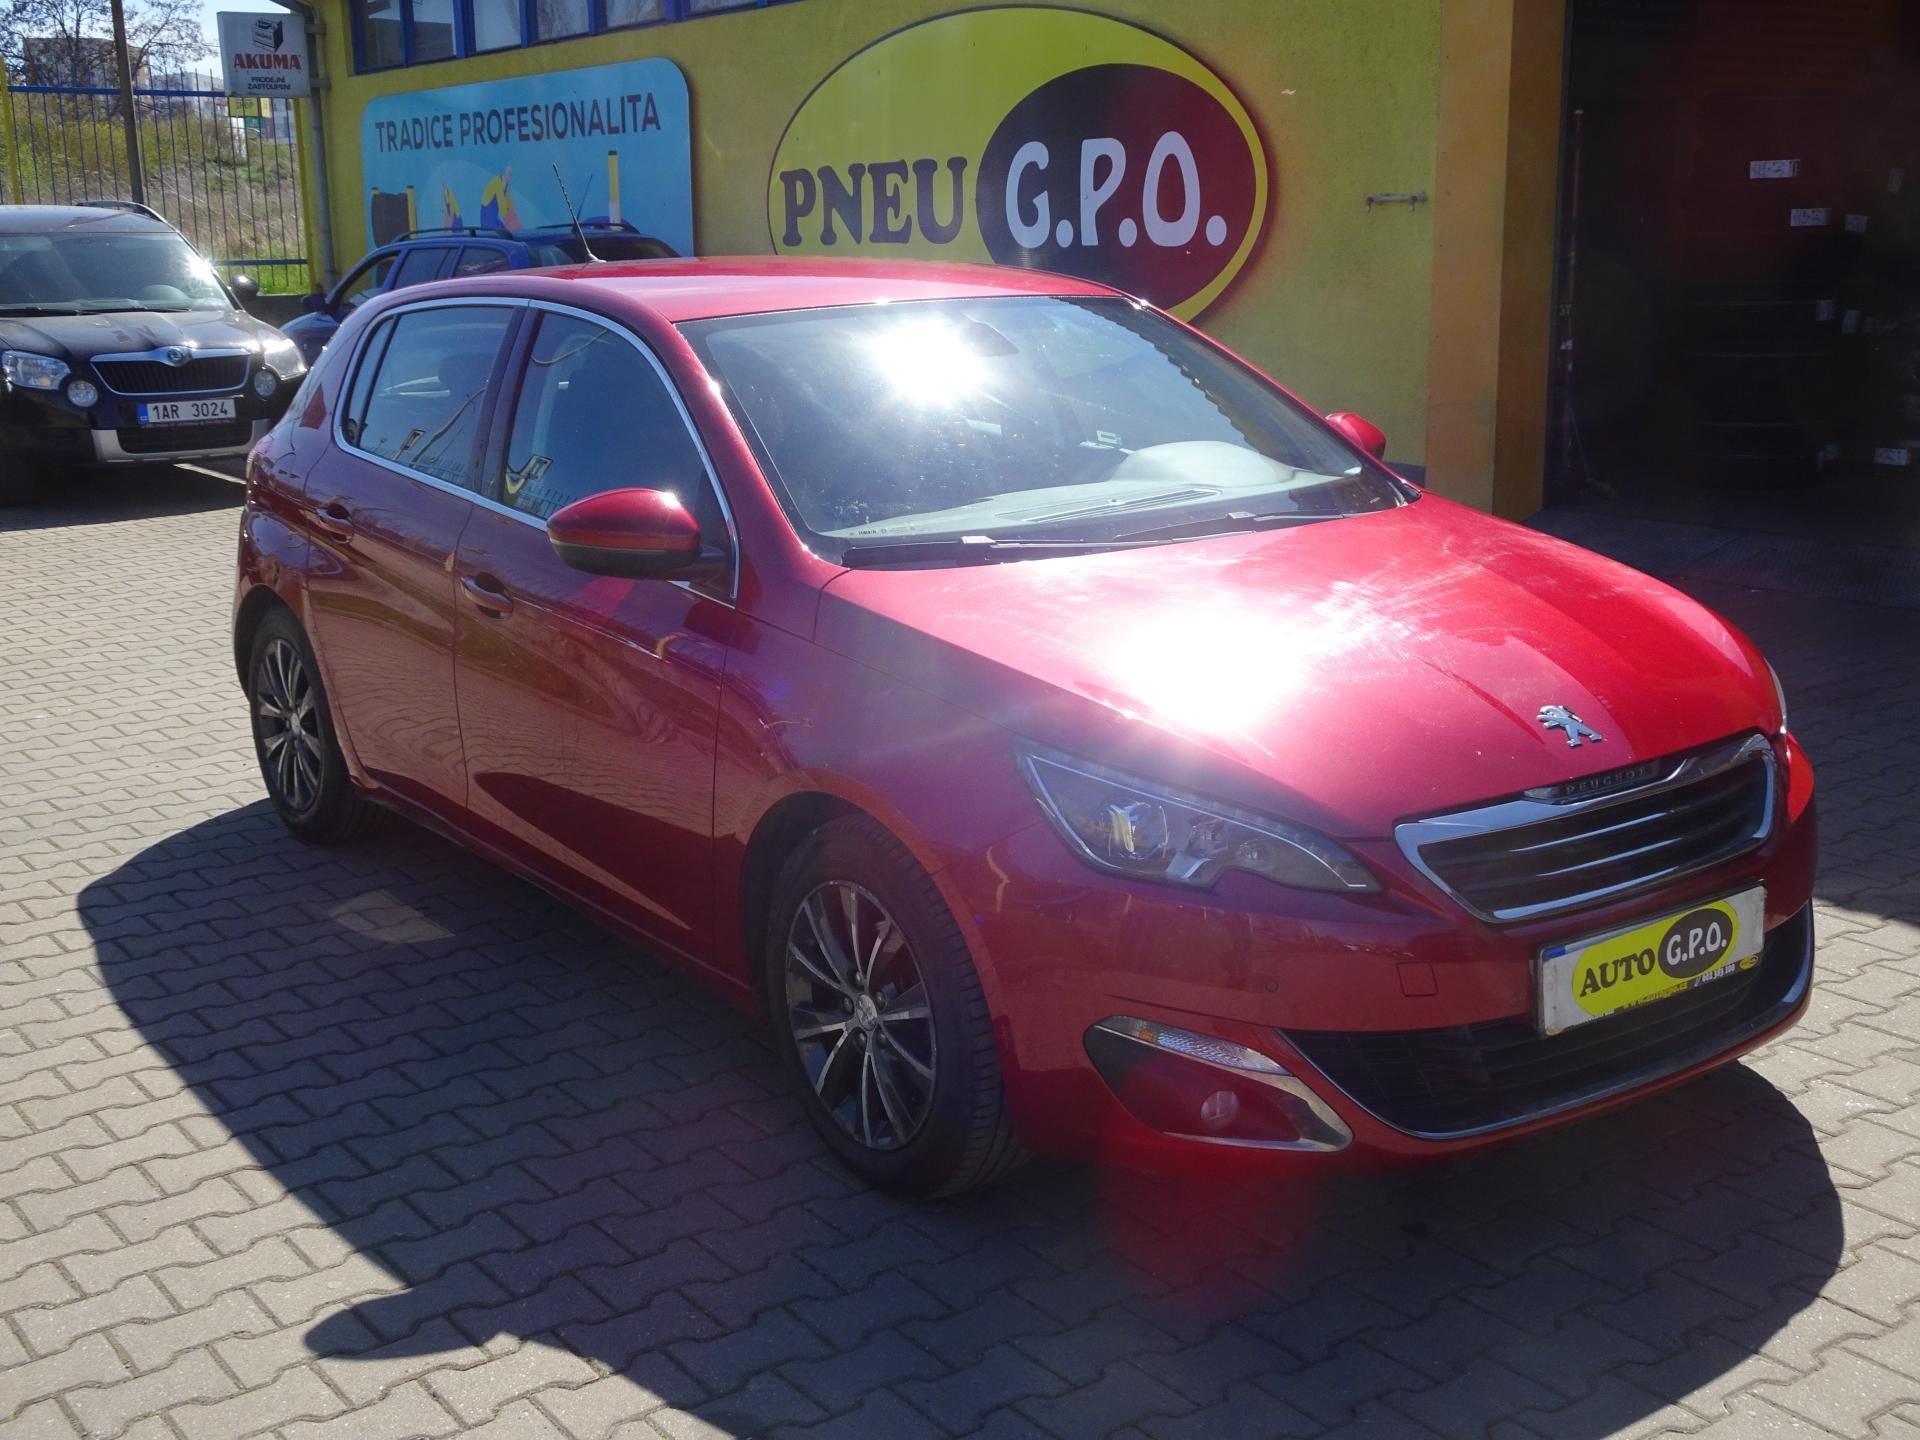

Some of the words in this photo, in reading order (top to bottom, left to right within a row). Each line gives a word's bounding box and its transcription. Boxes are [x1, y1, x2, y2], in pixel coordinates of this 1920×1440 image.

[233, 53, 302, 70] AKUMA
[375, 114, 454, 152] TRADICE
[459, 92, 661, 146] PROFESIONALITA
[779, 156, 968, 247] PNEU
[1005, 130, 1228, 248] G.P.O.
[152, 403, 180, 420] 1AR
[192, 401, 228, 418] 3024
[1566, 766, 1648, 795] PEUGEOT
[1579, 947, 1656, 998] AUTO
[1665, 921, 1728, 966] G.P.O.
